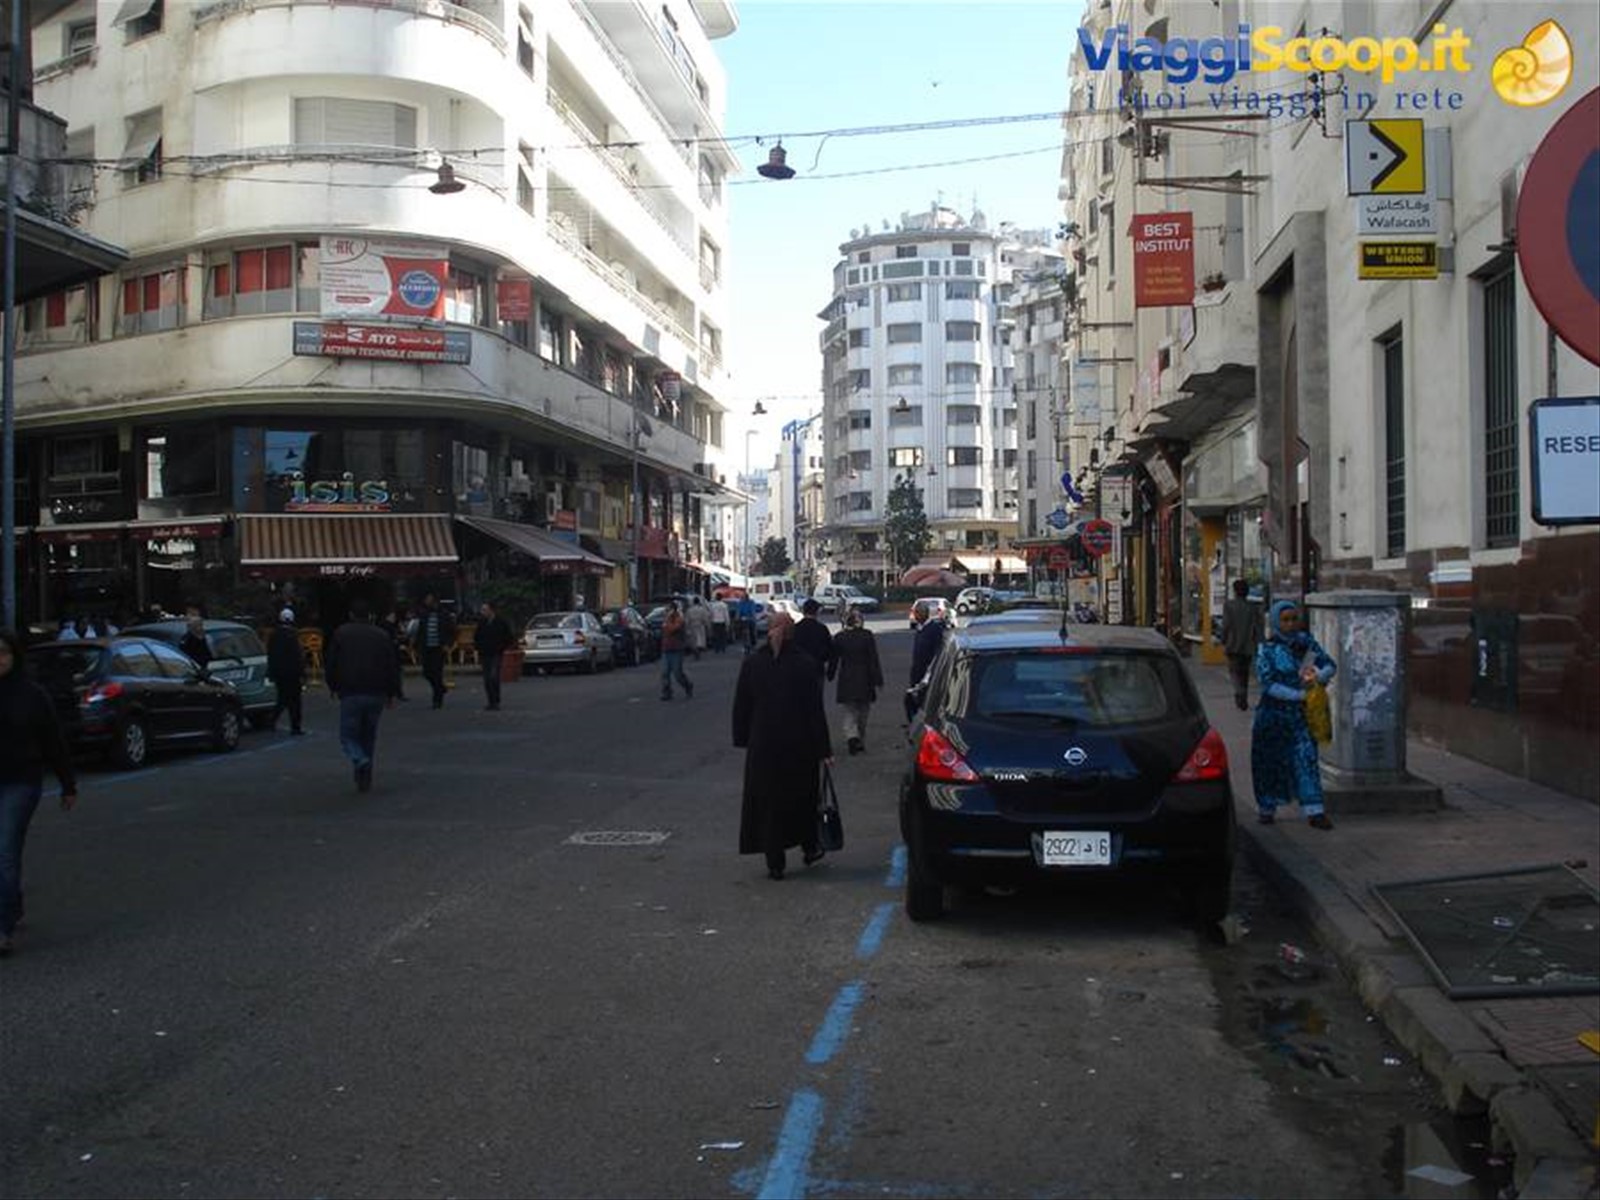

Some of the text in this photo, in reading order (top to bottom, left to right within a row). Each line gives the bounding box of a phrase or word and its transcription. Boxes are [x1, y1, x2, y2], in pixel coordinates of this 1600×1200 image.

[1367, 216, 1431, 228] Wafacash
[1144, 223, 1181, 237] BEST
[1136, 239, 1191, 253] INSTITUT
[1365, 246, 1424, 256] WESTERN
[1385, 255, 1424, 264] UNION
[367, 333, 397, 345] ATC
[1545, 436, 1600, 454] RESE
[290, 471, 389, 504] isis
[320, 565, 346, 575] ISIS
[1046, 838, 1076, 857] 2922
[1100, 838, 1108, 857] 6
